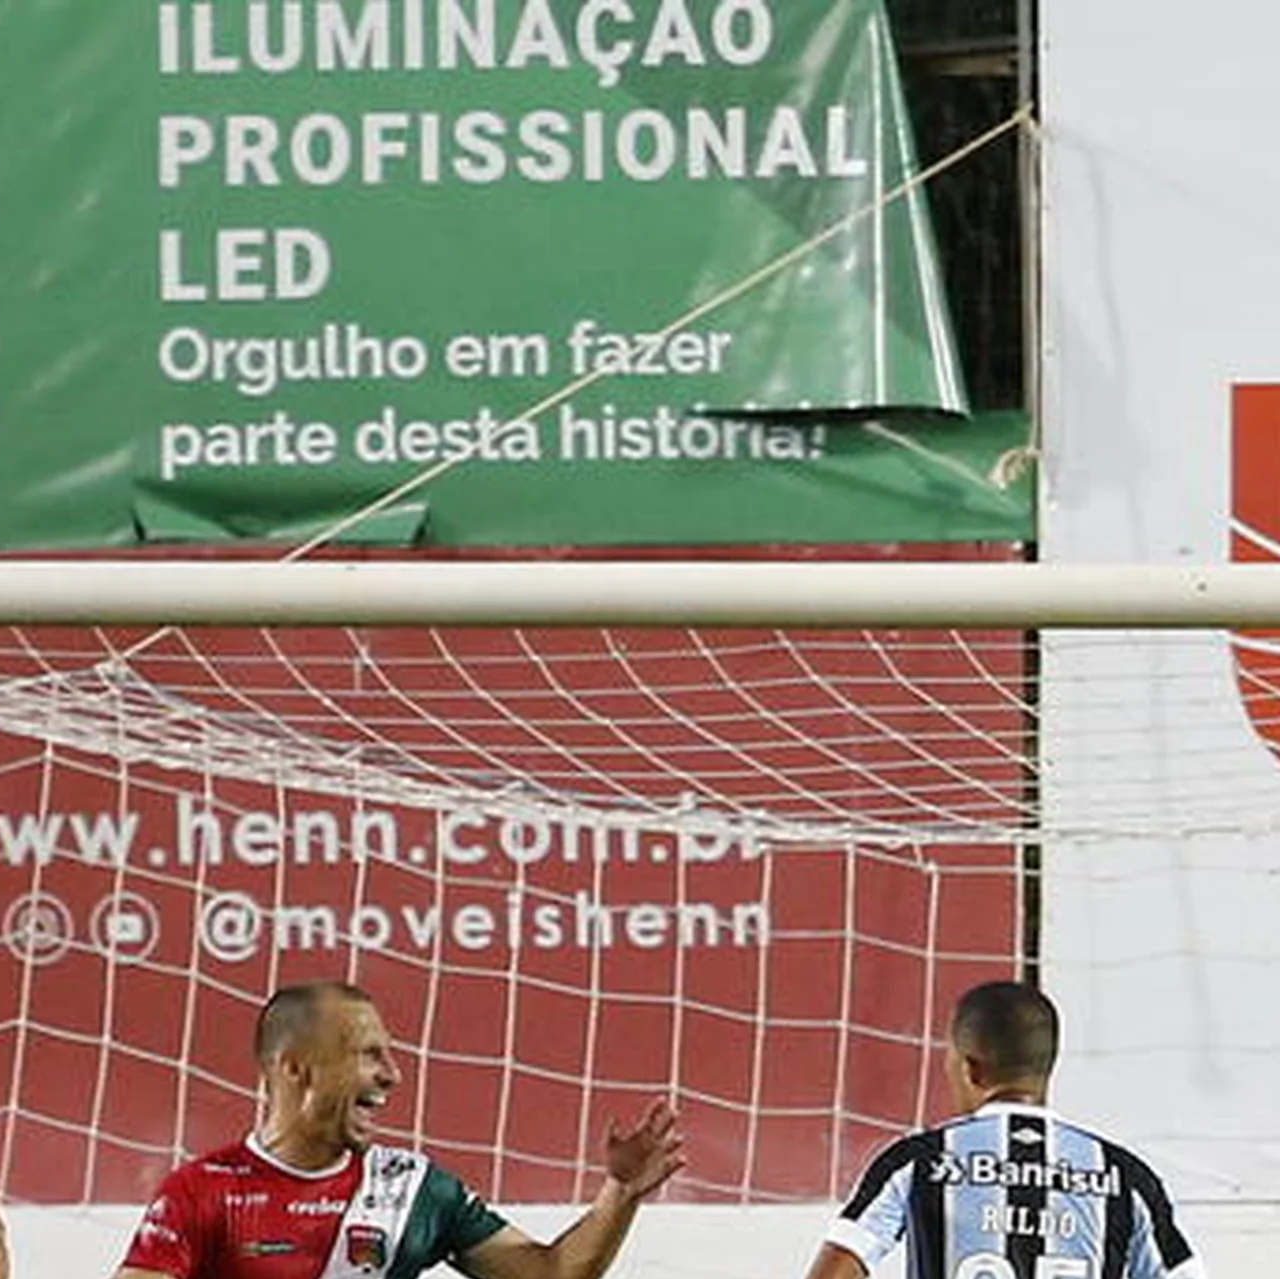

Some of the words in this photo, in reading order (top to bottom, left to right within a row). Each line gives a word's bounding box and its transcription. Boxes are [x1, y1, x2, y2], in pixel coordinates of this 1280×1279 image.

[158, 107, 868, 188] PROFISSIONAL
[158, 226, 332, 302] LED
[158, 323, 428, 396] Orgulho
[445, 333, 549, 377] em
[567, 322, 733, 376] fazer
[160, 411, 337, 479] parte
[354, 404, 542, 465] desta
[198, 888, 772, 962] @moveishenn
[972, 1153, 1121, 1197] Banrisul
